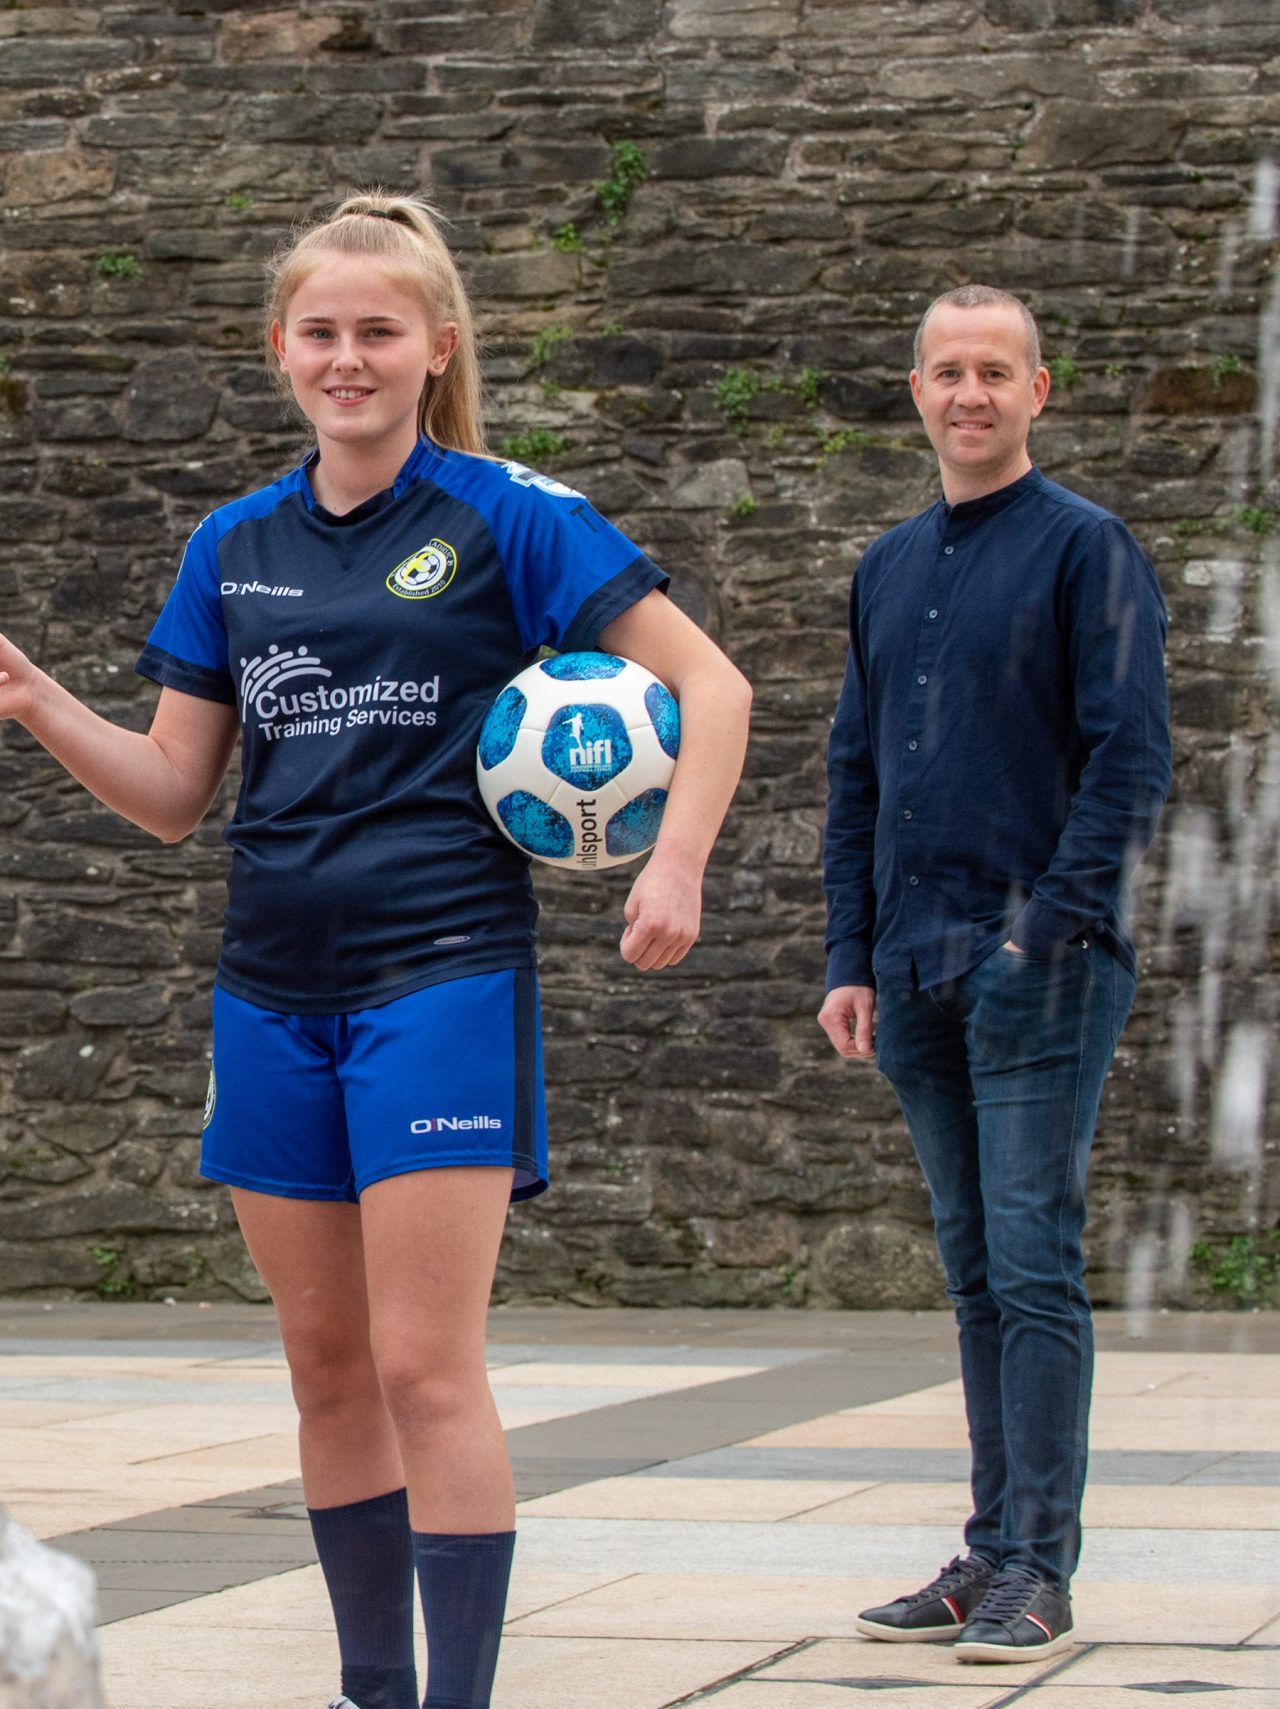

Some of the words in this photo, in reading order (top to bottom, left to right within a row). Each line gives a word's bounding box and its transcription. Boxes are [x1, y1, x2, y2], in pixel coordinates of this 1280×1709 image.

[255, 675, 440, 719] Customized
[258, 716, 342, 741] Training
[346, 706, 437, 727] Services
[570, 739, 612, 765] nifl
